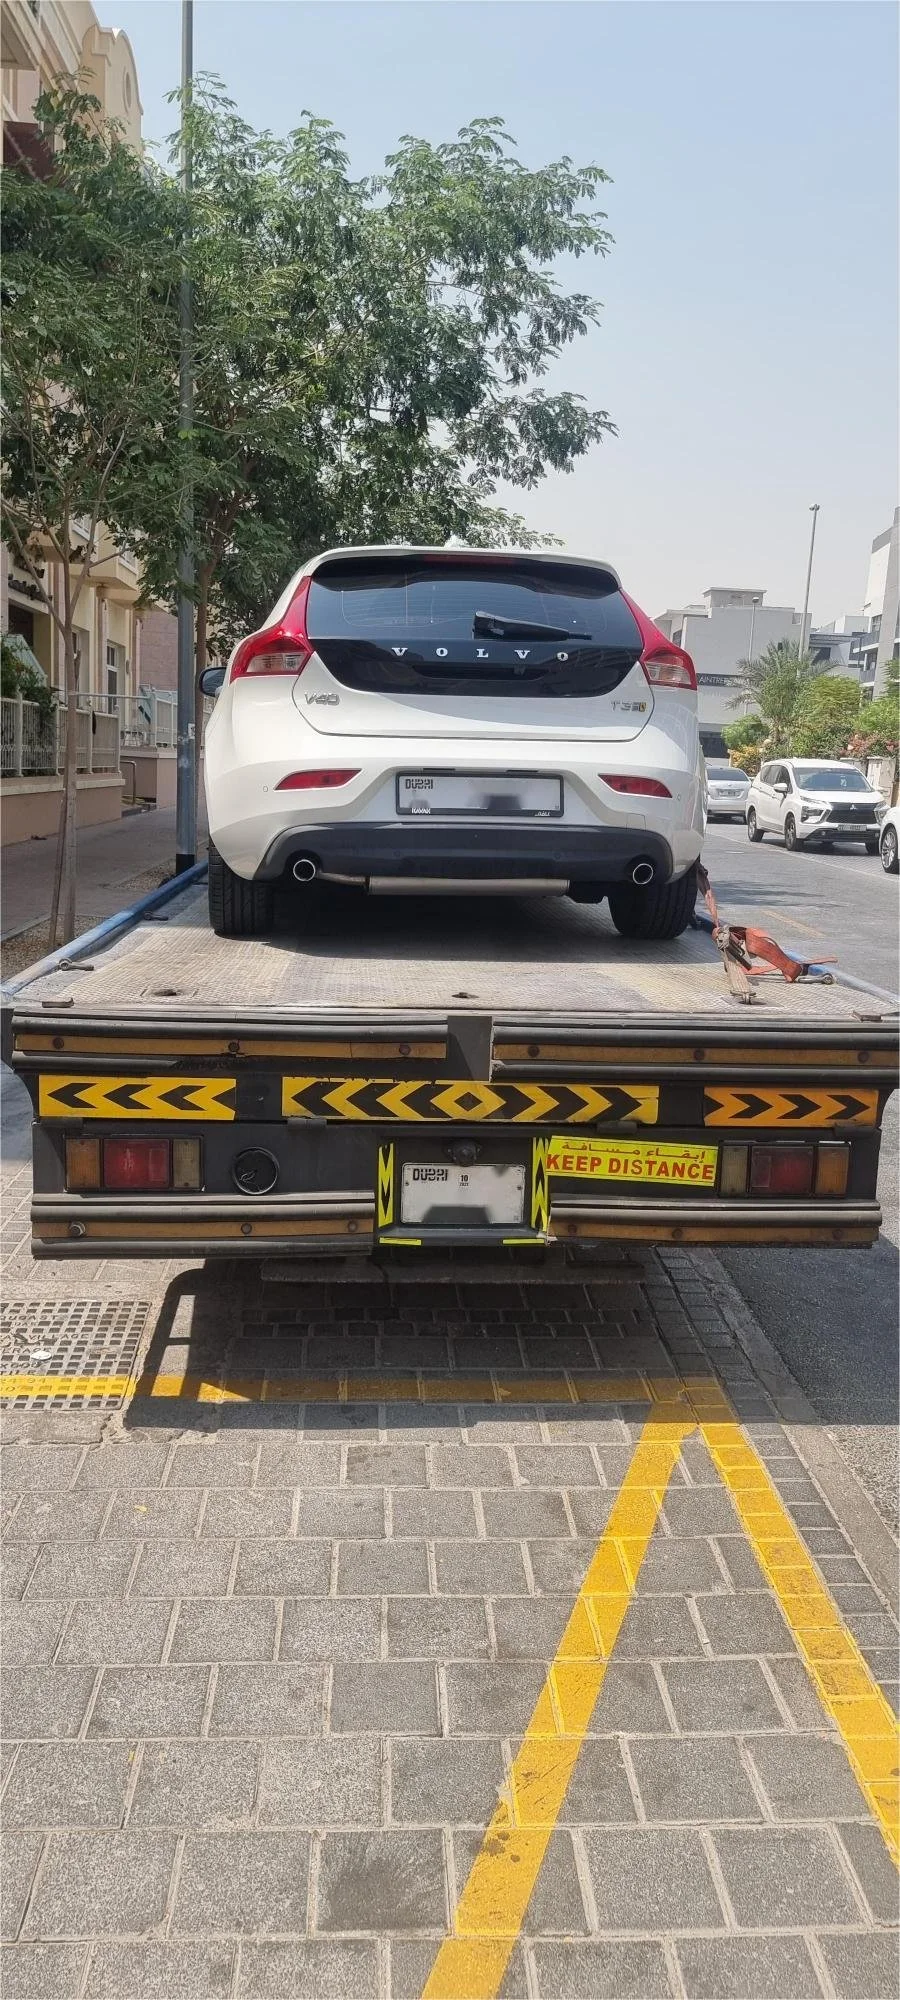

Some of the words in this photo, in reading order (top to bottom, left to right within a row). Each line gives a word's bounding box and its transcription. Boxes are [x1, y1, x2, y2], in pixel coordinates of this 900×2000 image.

[391, 647, 569, 662] VOLVO
[304, 691, 340, 706] V40
[561, 1142, 641, 1156] مسافة
[546, 1154, 602, 1173] KEEP
[608, 1157, 715, 1181] DISTANCE
[460, 1174, 469, 1183] 10
